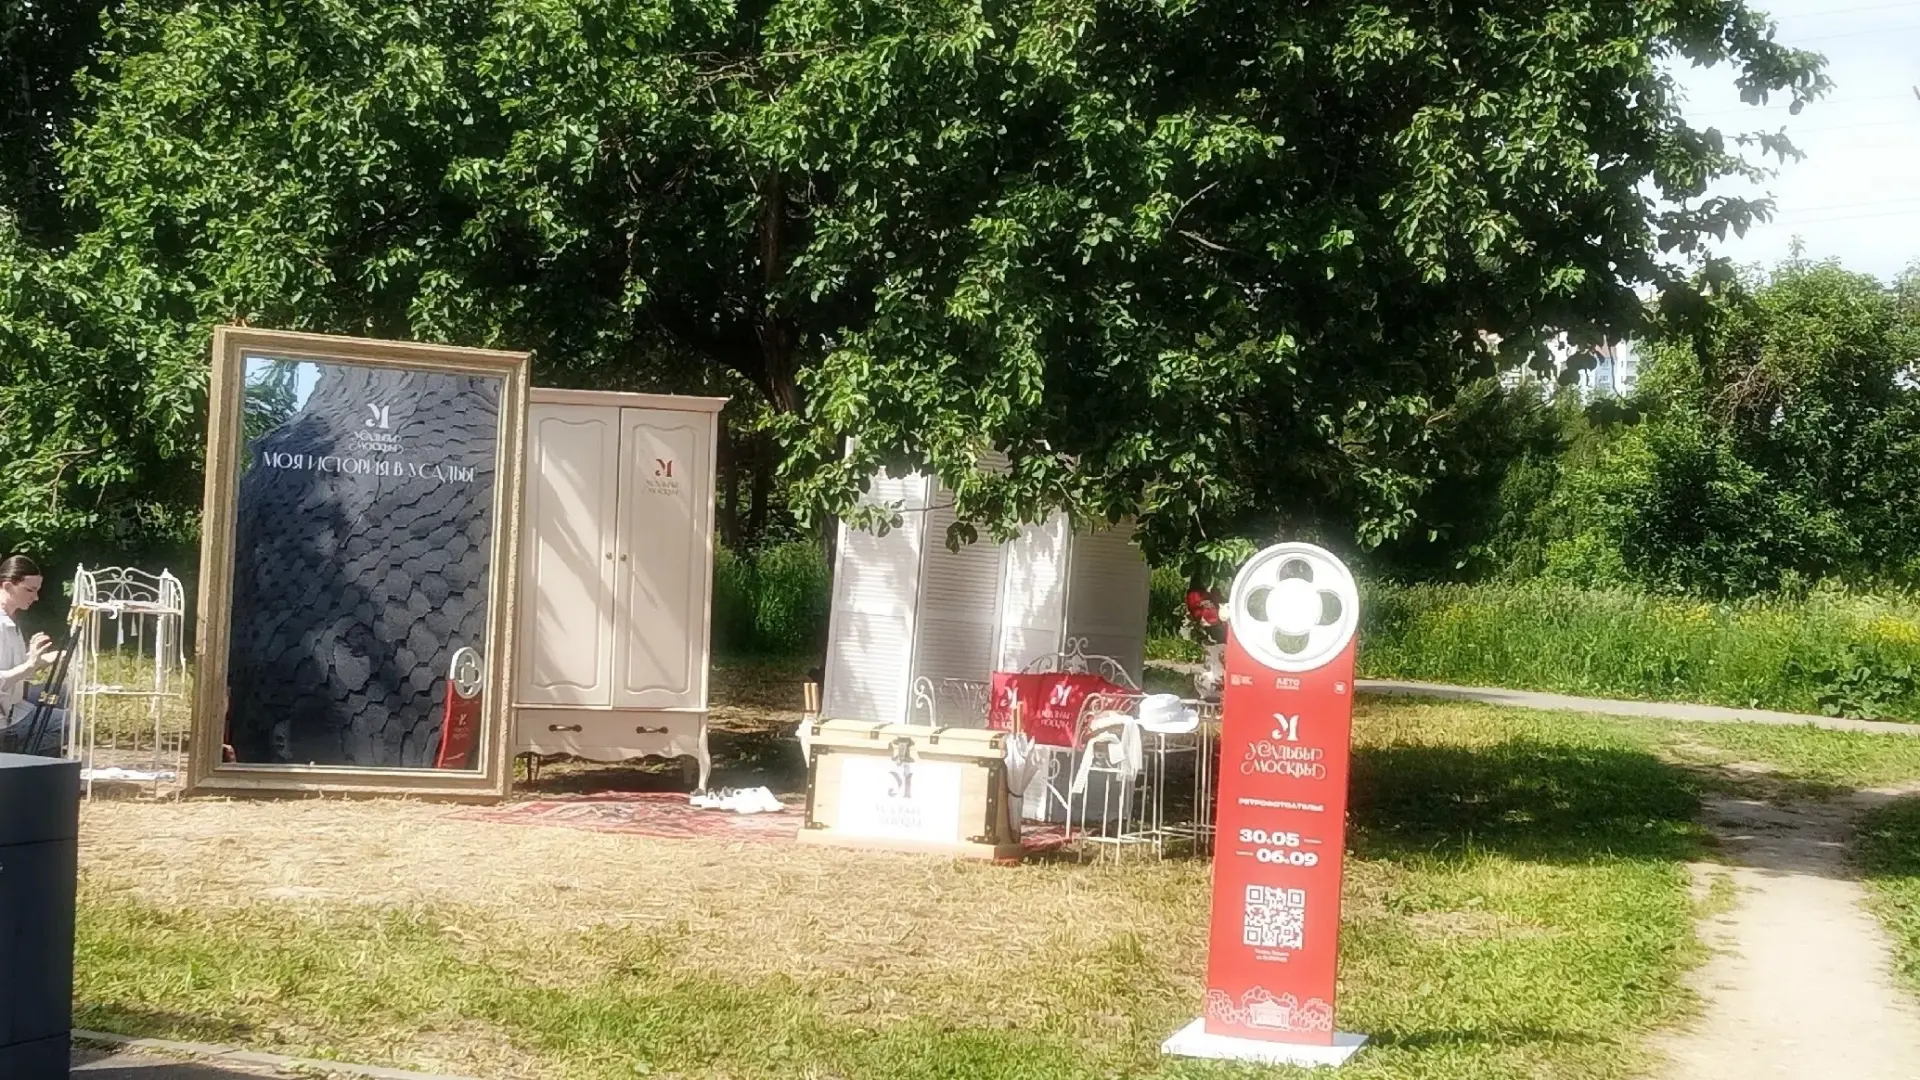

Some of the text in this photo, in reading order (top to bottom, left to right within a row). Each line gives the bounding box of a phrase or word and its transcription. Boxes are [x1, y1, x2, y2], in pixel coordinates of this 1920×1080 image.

[262, 451, 304, 470] МОЯ
[308, 455, 390, 476] ИСТОРИЯ
[393, 461, 403, 477] В
[1240, 759, 1326, 780] МОСКВЫ
[1239, 827, 1300, 848] 30.05
[1256, 847, 1319, 868] 06.09
